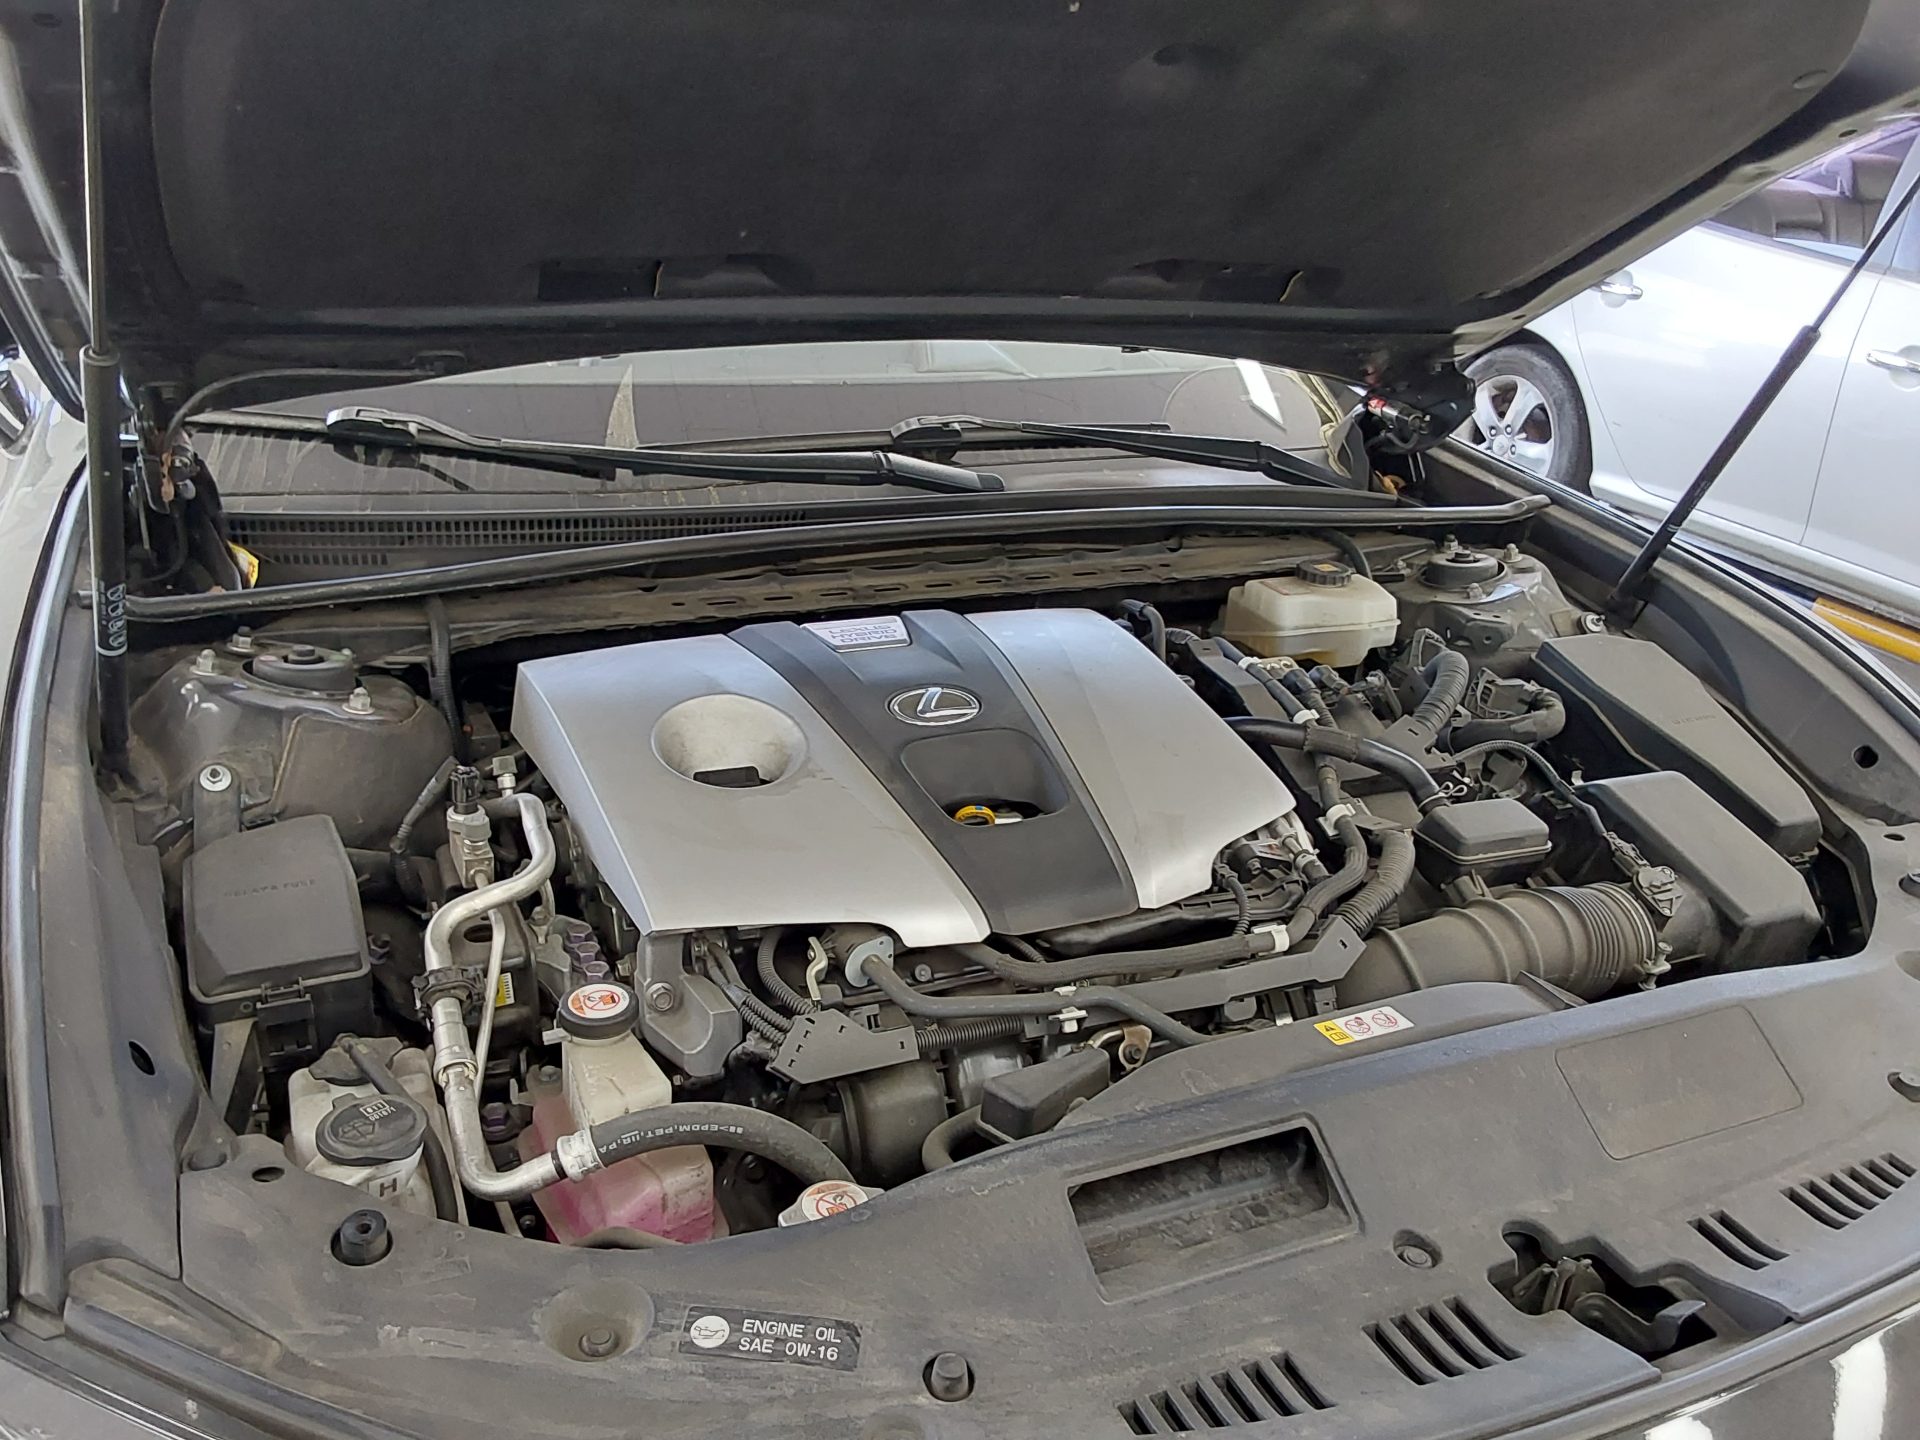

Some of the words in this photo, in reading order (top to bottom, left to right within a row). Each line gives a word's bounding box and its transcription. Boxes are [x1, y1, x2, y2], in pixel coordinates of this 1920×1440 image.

[828, 624, 891, 634] LEXUS
[830, 628, 897, 639] HYBRID
[840, 634, 897, 643] DRIVE
[379, 1177, 397, 1197] H
[742, 1318, 805, 1339] ENGINE
[815, 1327, 842, 1343] OIL
[738, 1337, 774, 1354] SAE
[785, 1341, 839, 1361] 0W-16
